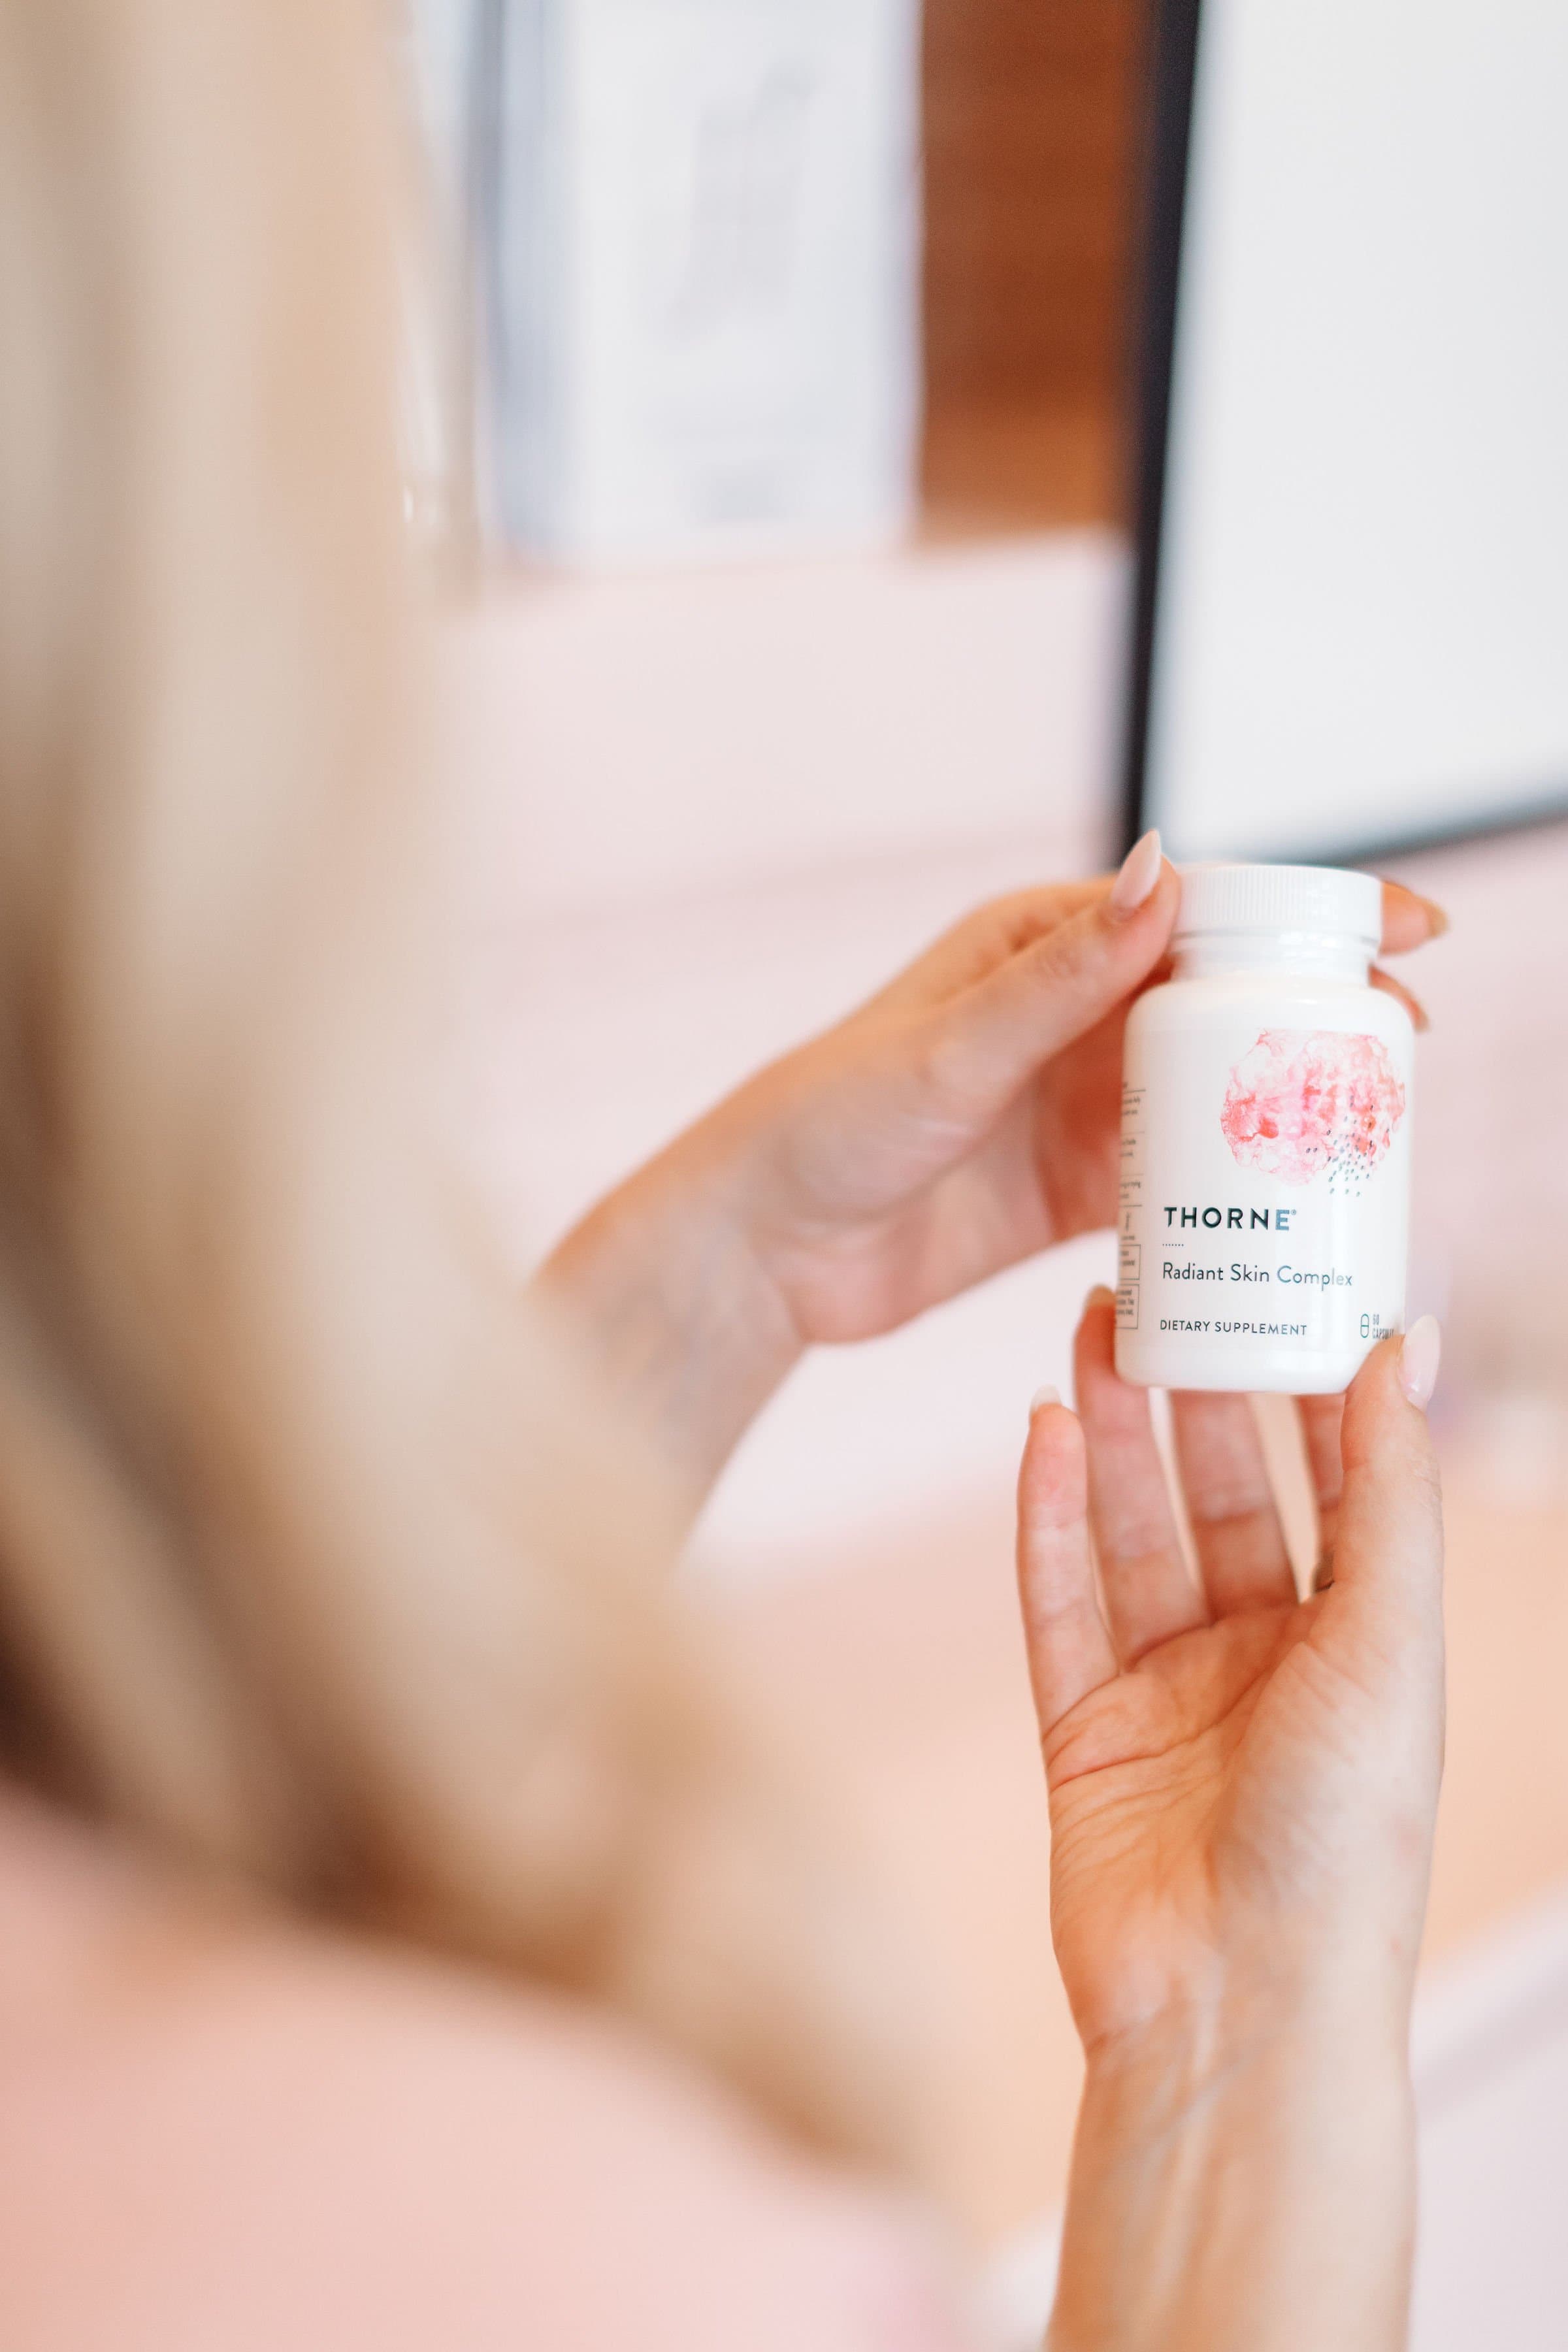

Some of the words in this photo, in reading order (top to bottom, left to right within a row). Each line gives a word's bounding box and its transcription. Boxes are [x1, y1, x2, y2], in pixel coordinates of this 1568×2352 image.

[1163, 1262, 1224, 1281] Radiant
[1230, 1264, 1269, 1282] Skin
[1277, 1265, 1352, 1292] Complex
[1160, 1320, 1211, 1331] DIETARY
[1214, 1322, 1307, 1336] SUPPLEMENT
